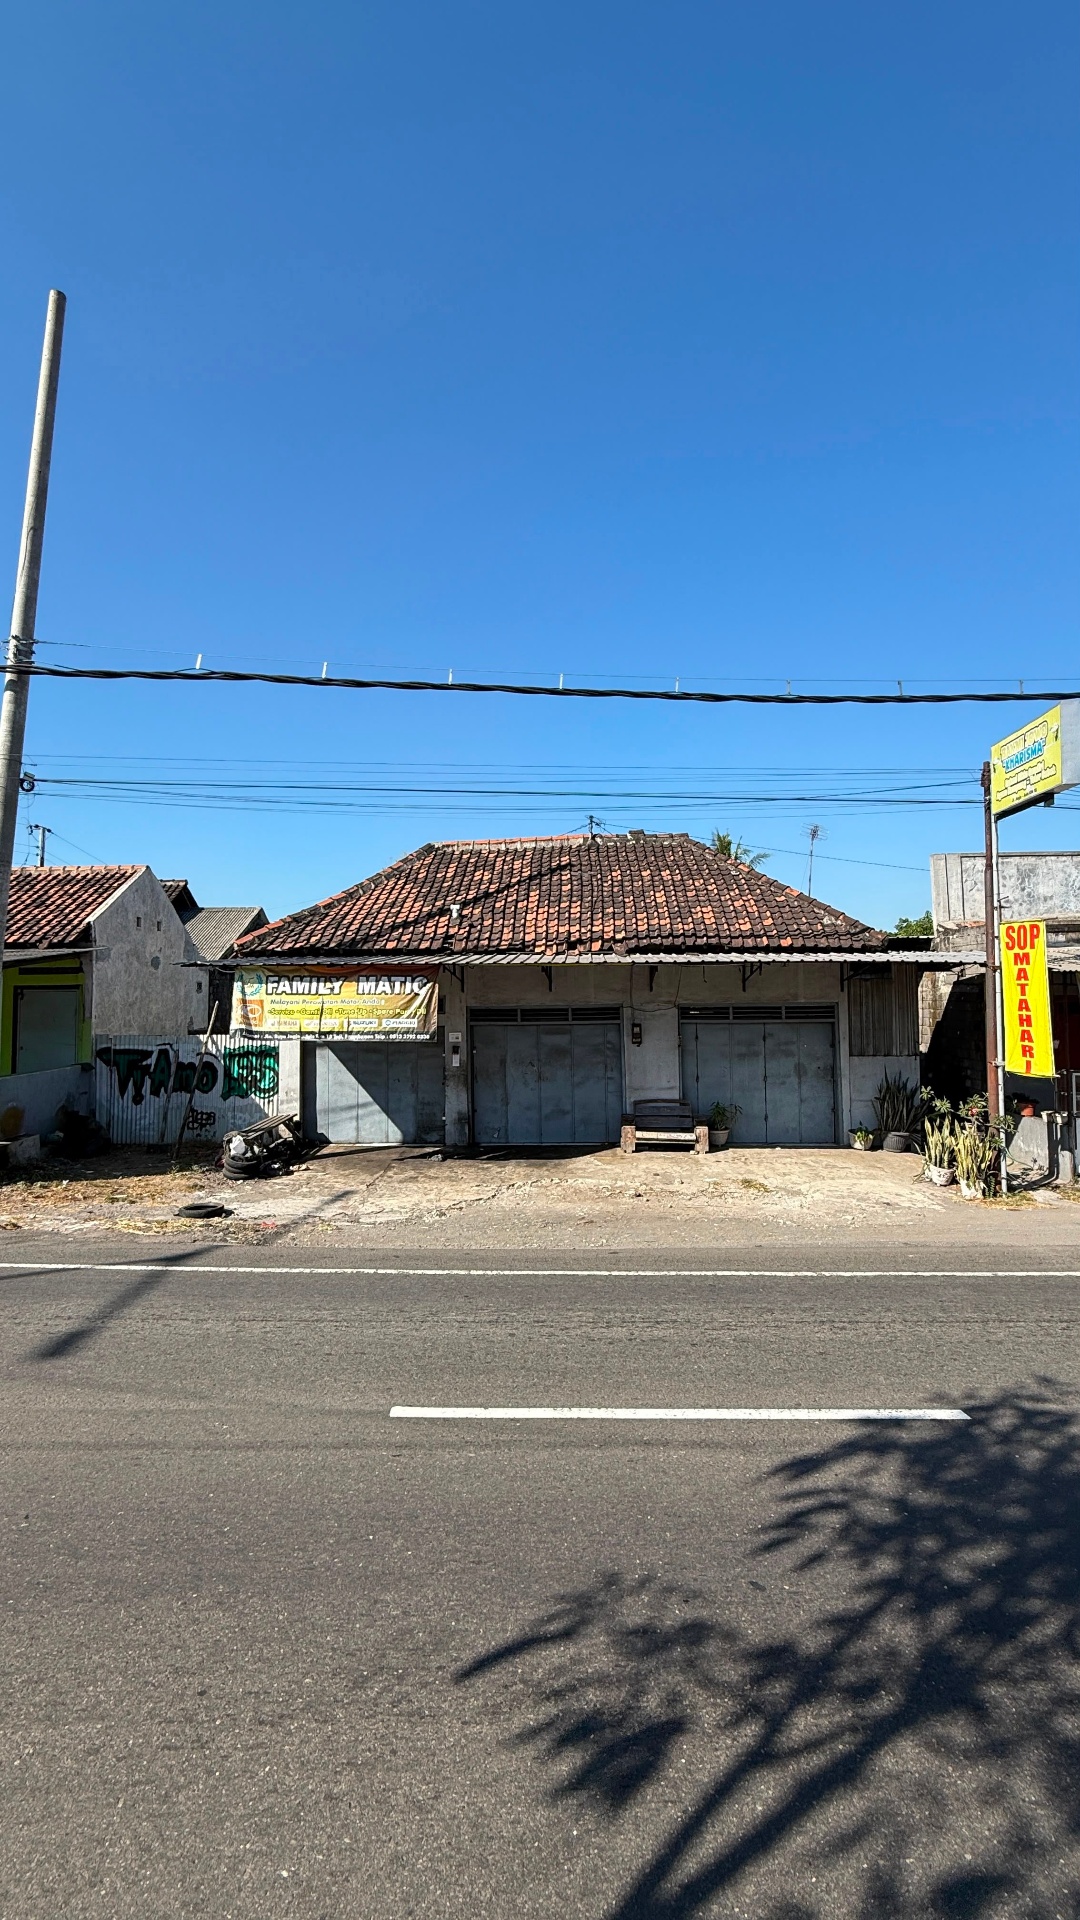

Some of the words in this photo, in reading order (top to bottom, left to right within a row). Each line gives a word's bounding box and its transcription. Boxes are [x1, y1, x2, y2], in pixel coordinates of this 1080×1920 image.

[1005, 924, 1041, 951] SOP
[266, 975, 346, 995] FAMILY
[356, 975, 428, 995] MATIC
[1013, 952, 1035, 1074] MATAHARI
